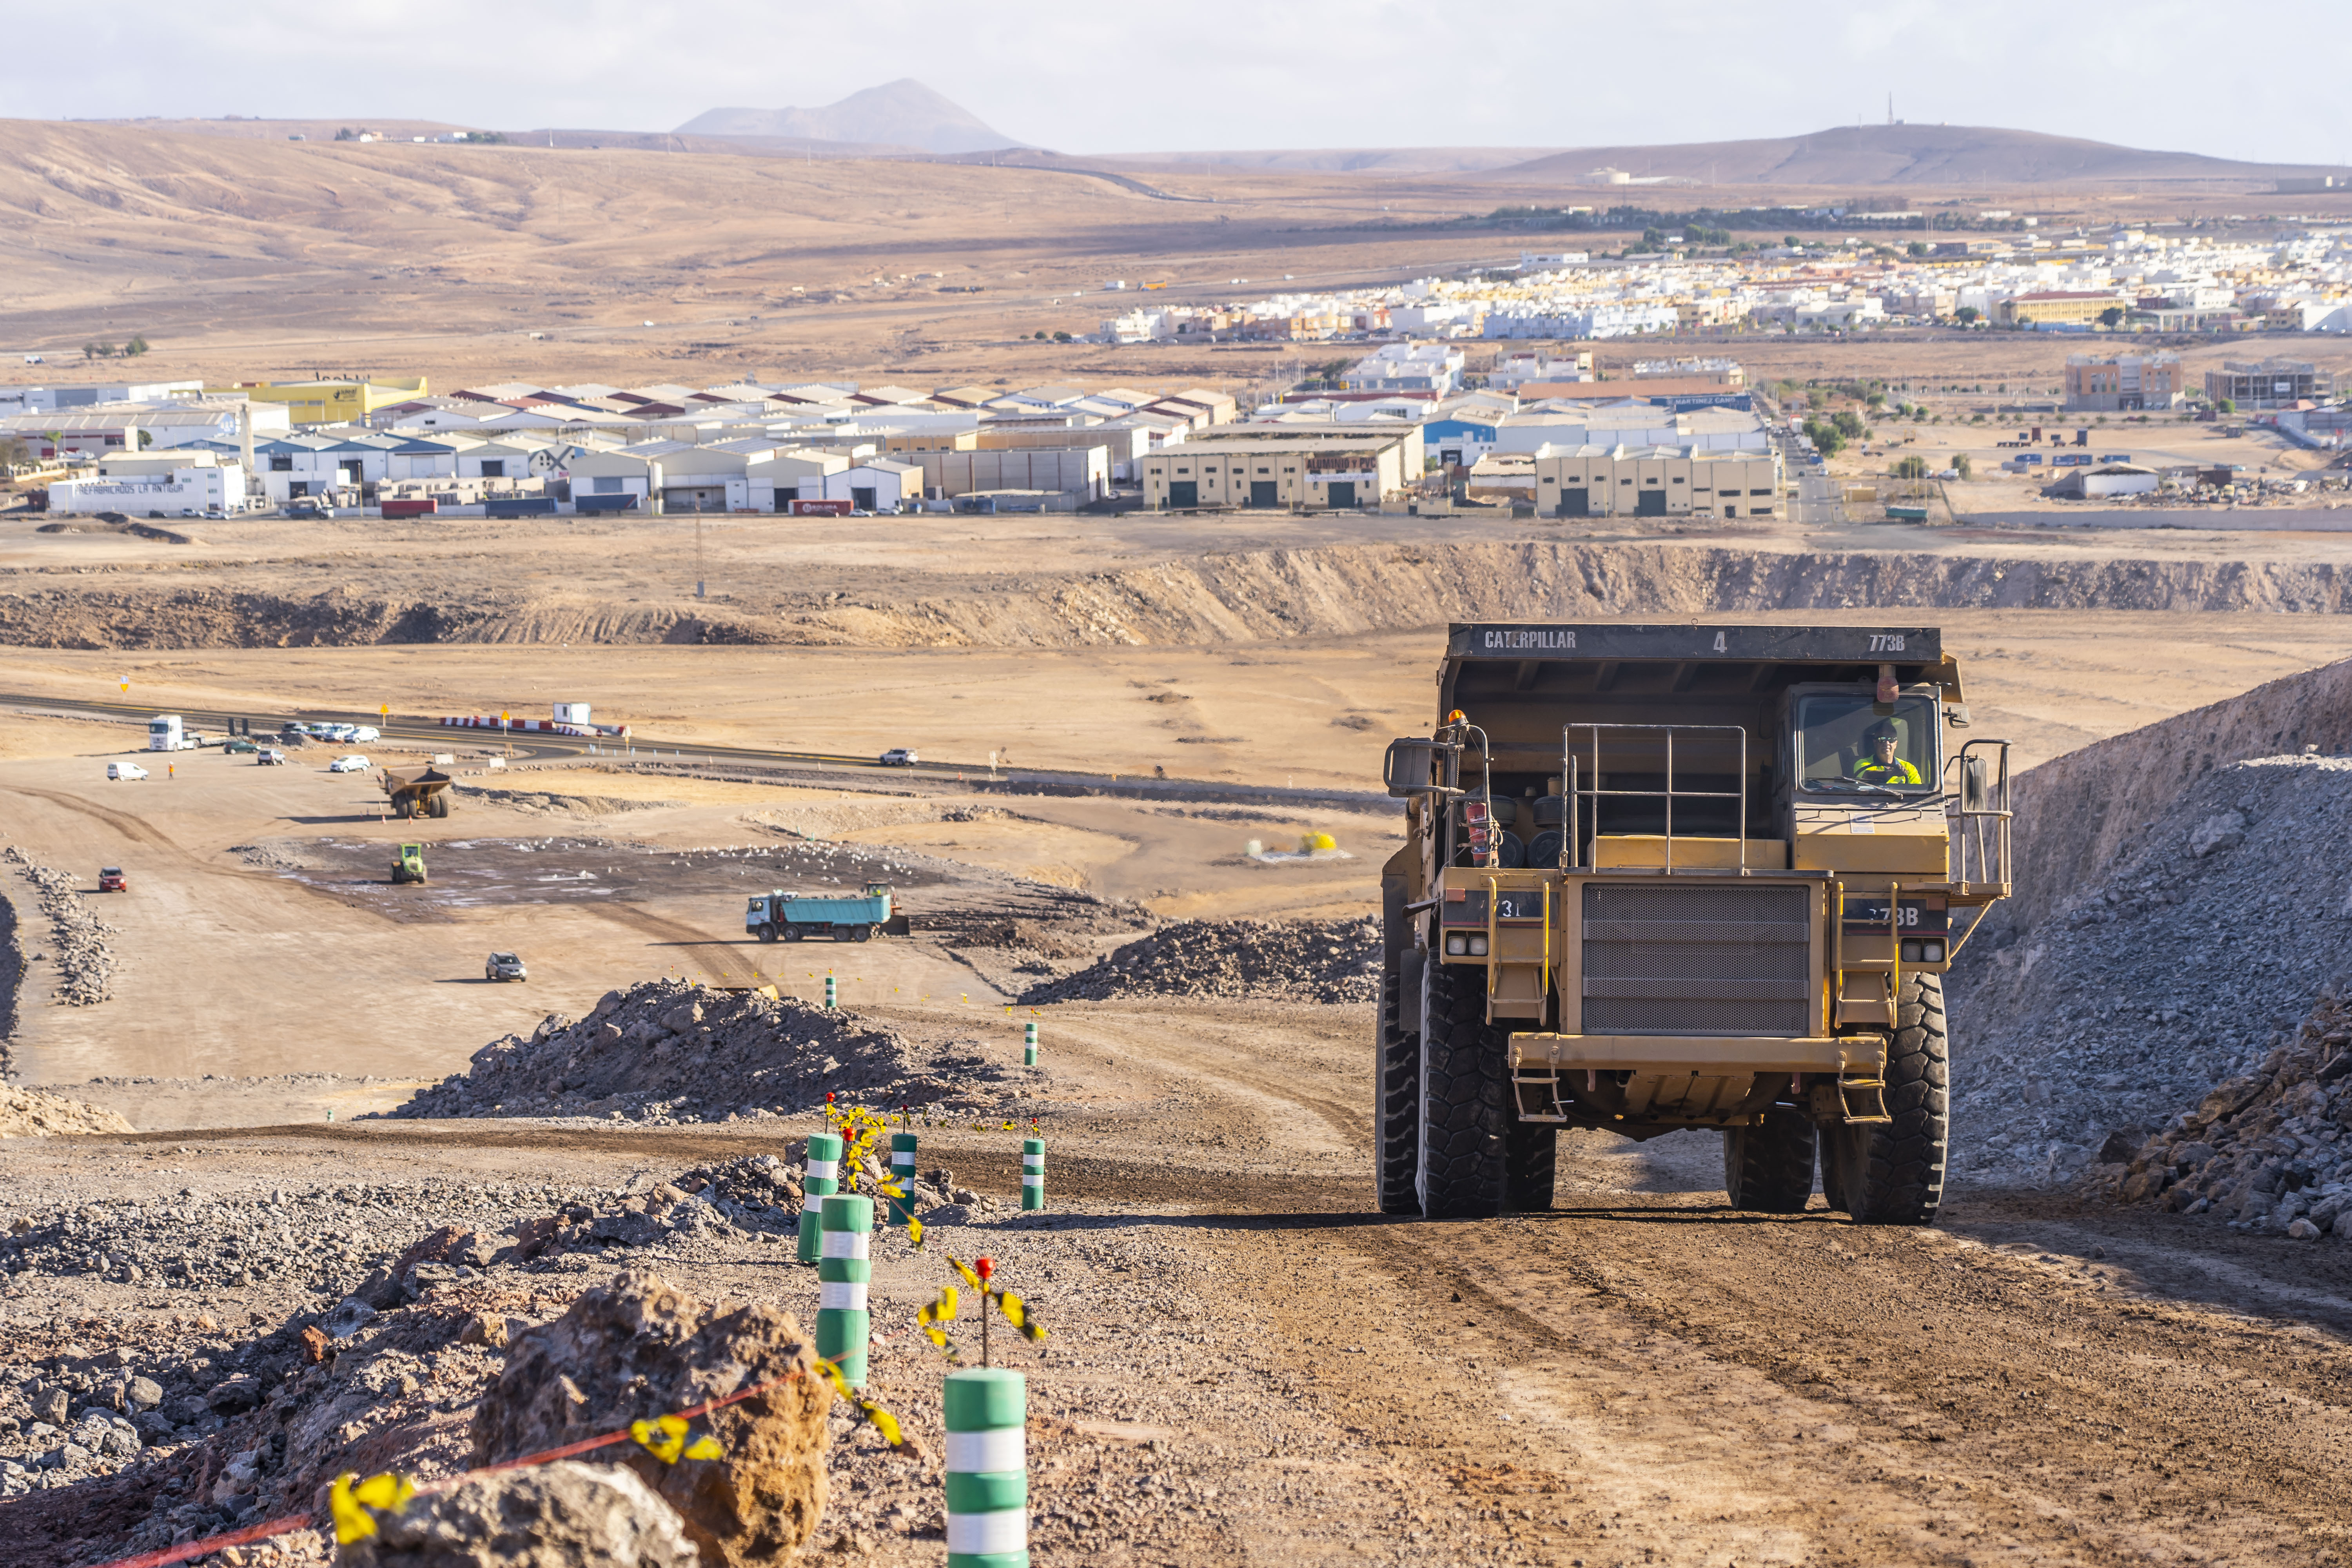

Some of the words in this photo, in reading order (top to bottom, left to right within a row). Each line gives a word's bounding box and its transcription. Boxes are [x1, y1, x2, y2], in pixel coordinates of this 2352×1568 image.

[1307, 459, 1349, 469] ALUMINIO
[1359, 457, 1376, 468] PVC
[138, 484, 148, 494] LA
[152, 484, 184, 493] ANTIGUA
[1485, 631, 1576, 648] CATERPILLAR
[1713, 631, 1727, 653] 4
[1869, 635, 1905, 651] 773B
